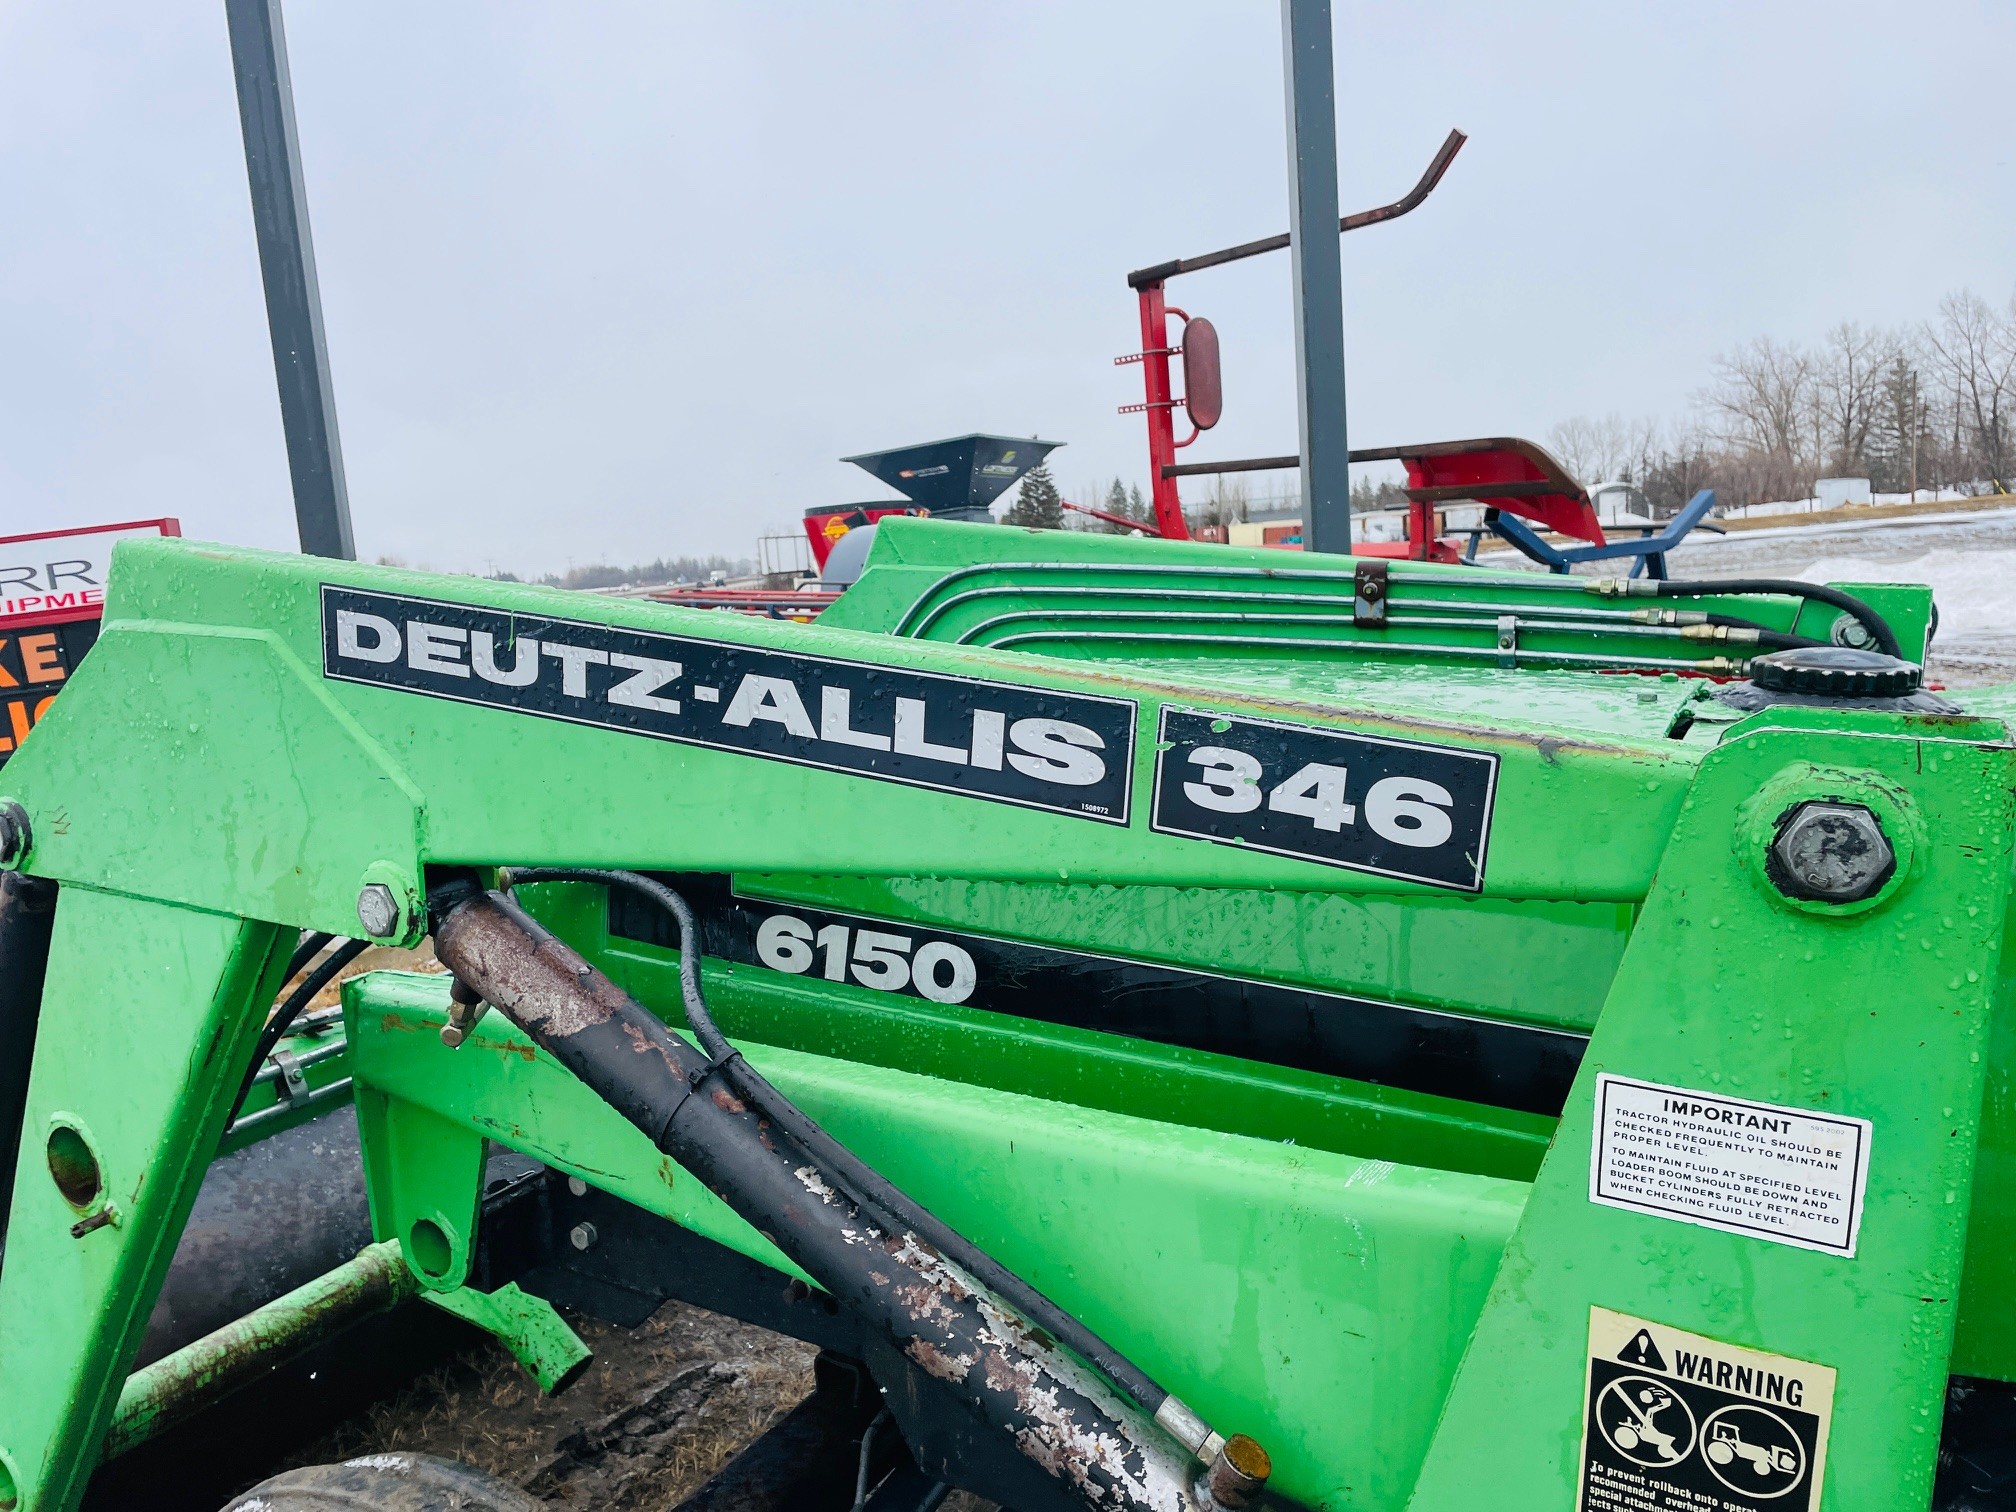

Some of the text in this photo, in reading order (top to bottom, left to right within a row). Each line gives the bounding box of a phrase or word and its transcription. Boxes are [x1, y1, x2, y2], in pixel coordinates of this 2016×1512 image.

[336, 609, 1106, 785] DEUTZ-ALLIS
[1081, 803, 1109, 814] 1508972
[1183, 746, 1453, 847] 346
[756, 915, 976, 1004] 6150
[1616, 1108, 1842, 1159] TRACTOR HYDRAULIC OIL SHOULD BE
[1664, 1099, 1791, 1134] IMPORTANT
[1613, 1131, 1708, 1157] PROPER LEVEL.
[1615, 1120, 1838, 1171] CHECKED FREQUENTLY TO MAINTAIN
[1610, 1169, 1839, 1225] BUCKET CYLINDERS FULLY RETRACTED
[1611, 1159, 1828, 1209] LOADER BOOM SHOULD BE DOWN AND
[1612, 1147, 1841, 1201] TO MAINTAIN FLUID AT SPECIFIED LEVEL
[1610, 1182, 1789, 1226] WHEN CHECKING FLUID LEVEL.
[1675, 1349, 1803, 1407] WARNING
[1590, 1474, 1656, 1500] recommended
[1590, 1486, 1622, 1502] special
[1607, 1467, 1646, 1485] prevent
[1649, 1480, 1692, 1499] rollback
[1694, 1493, 1719, 1507] onto
